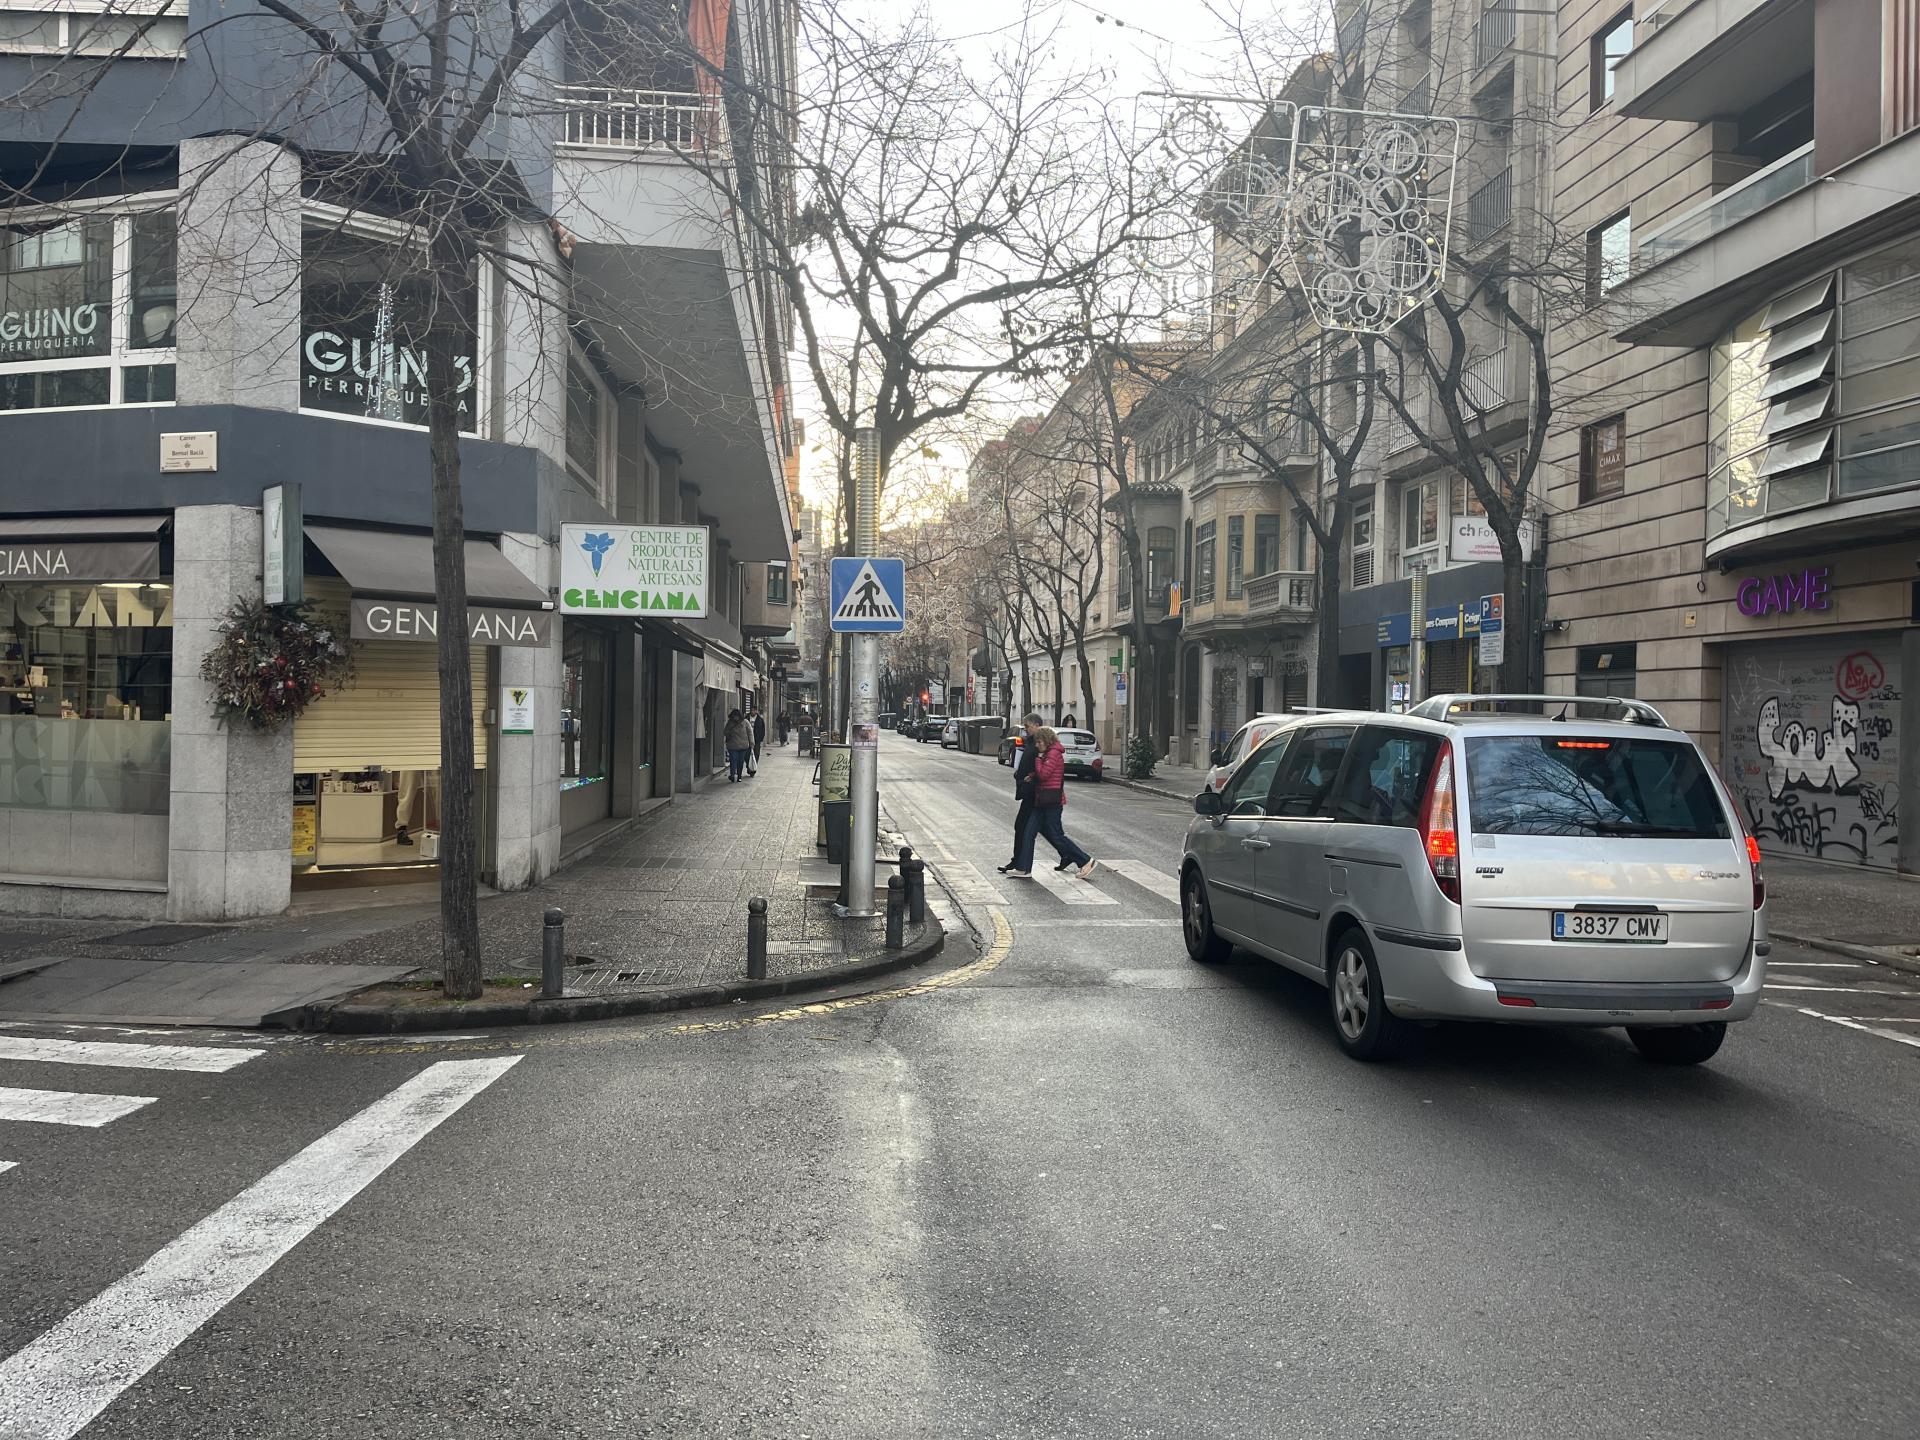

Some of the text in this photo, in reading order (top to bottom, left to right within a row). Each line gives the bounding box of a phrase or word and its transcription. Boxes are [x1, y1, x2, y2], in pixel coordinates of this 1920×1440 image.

[1, 336, 95, 352] PERRUQUERIA
[1600, 453, 1621, 468] CIMAX
[630, 530, 703, 545] CENTRE DE
[632, 544, 703, 559] PRODUCTES
[627, 558, 703, 572] NATURALS I
[638, 572, 703, 586] ARTESANS
[563, 588, 701, 611] GENCIANA
[1736, 567, 1829, 617] GAME
[1482, 600, 1490, 617] P
[366, 606, 538, 642] GENANA
[1435, 617, 1458, 628] Company
[1464, 612, 1480, 624] Ceigr
[1572, 916, 1619, 936] 3837
[1626, 917, 1660, 937] CMV
